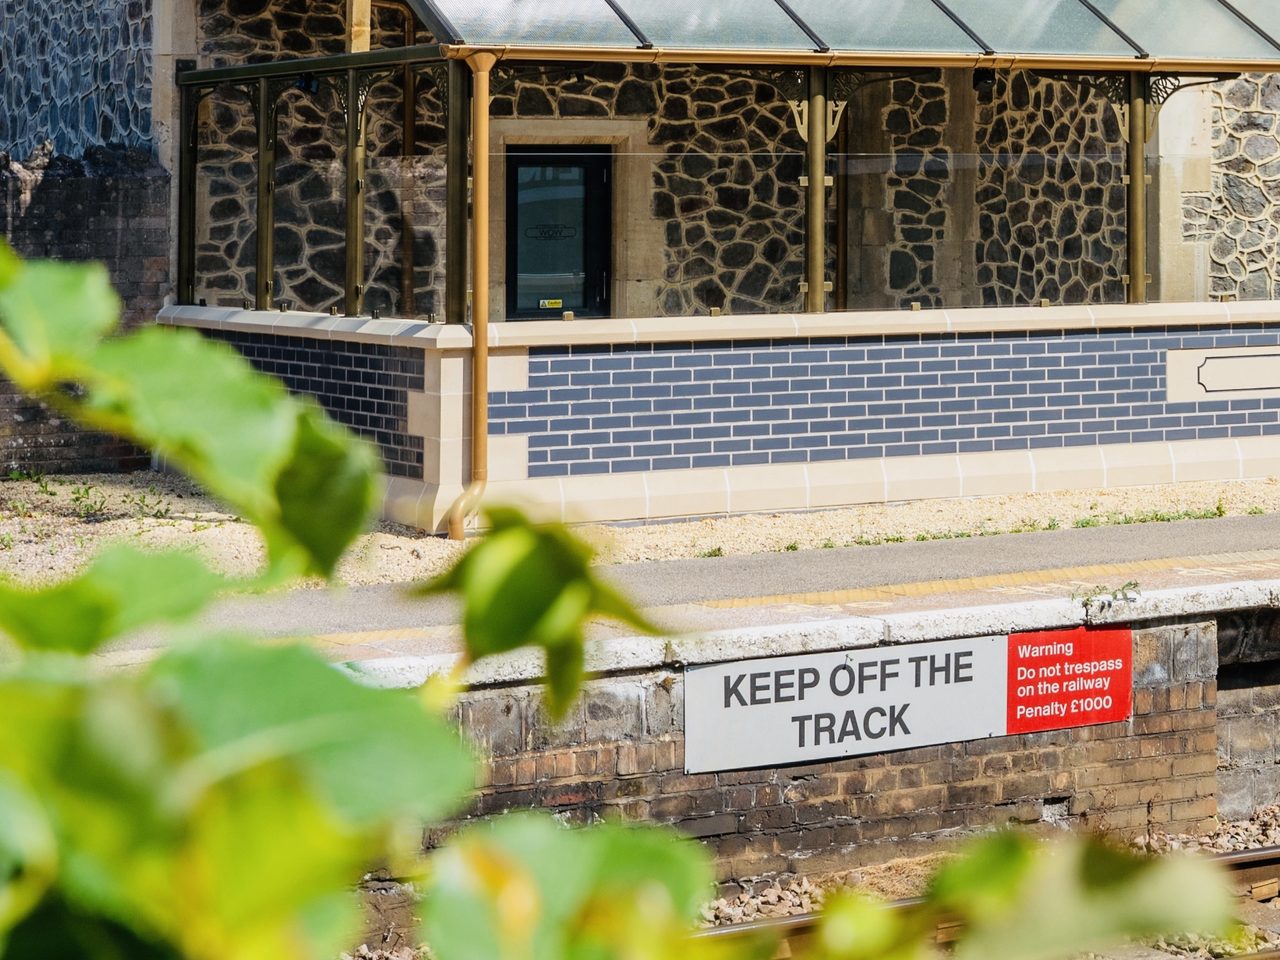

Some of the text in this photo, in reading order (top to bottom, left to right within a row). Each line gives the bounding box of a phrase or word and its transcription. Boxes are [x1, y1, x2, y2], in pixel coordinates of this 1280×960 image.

[1018, 642, 1073, 658] Warning
[723, 650, 973, 708] KEEP OFF THE
[1017, 658, 1122, 680] Do not trespass
[1017, 677, 1110, 697] on the railway
[1016, 695, 1112, 719] Penalty £1000
[791, 704, 911, 748] TRACK
